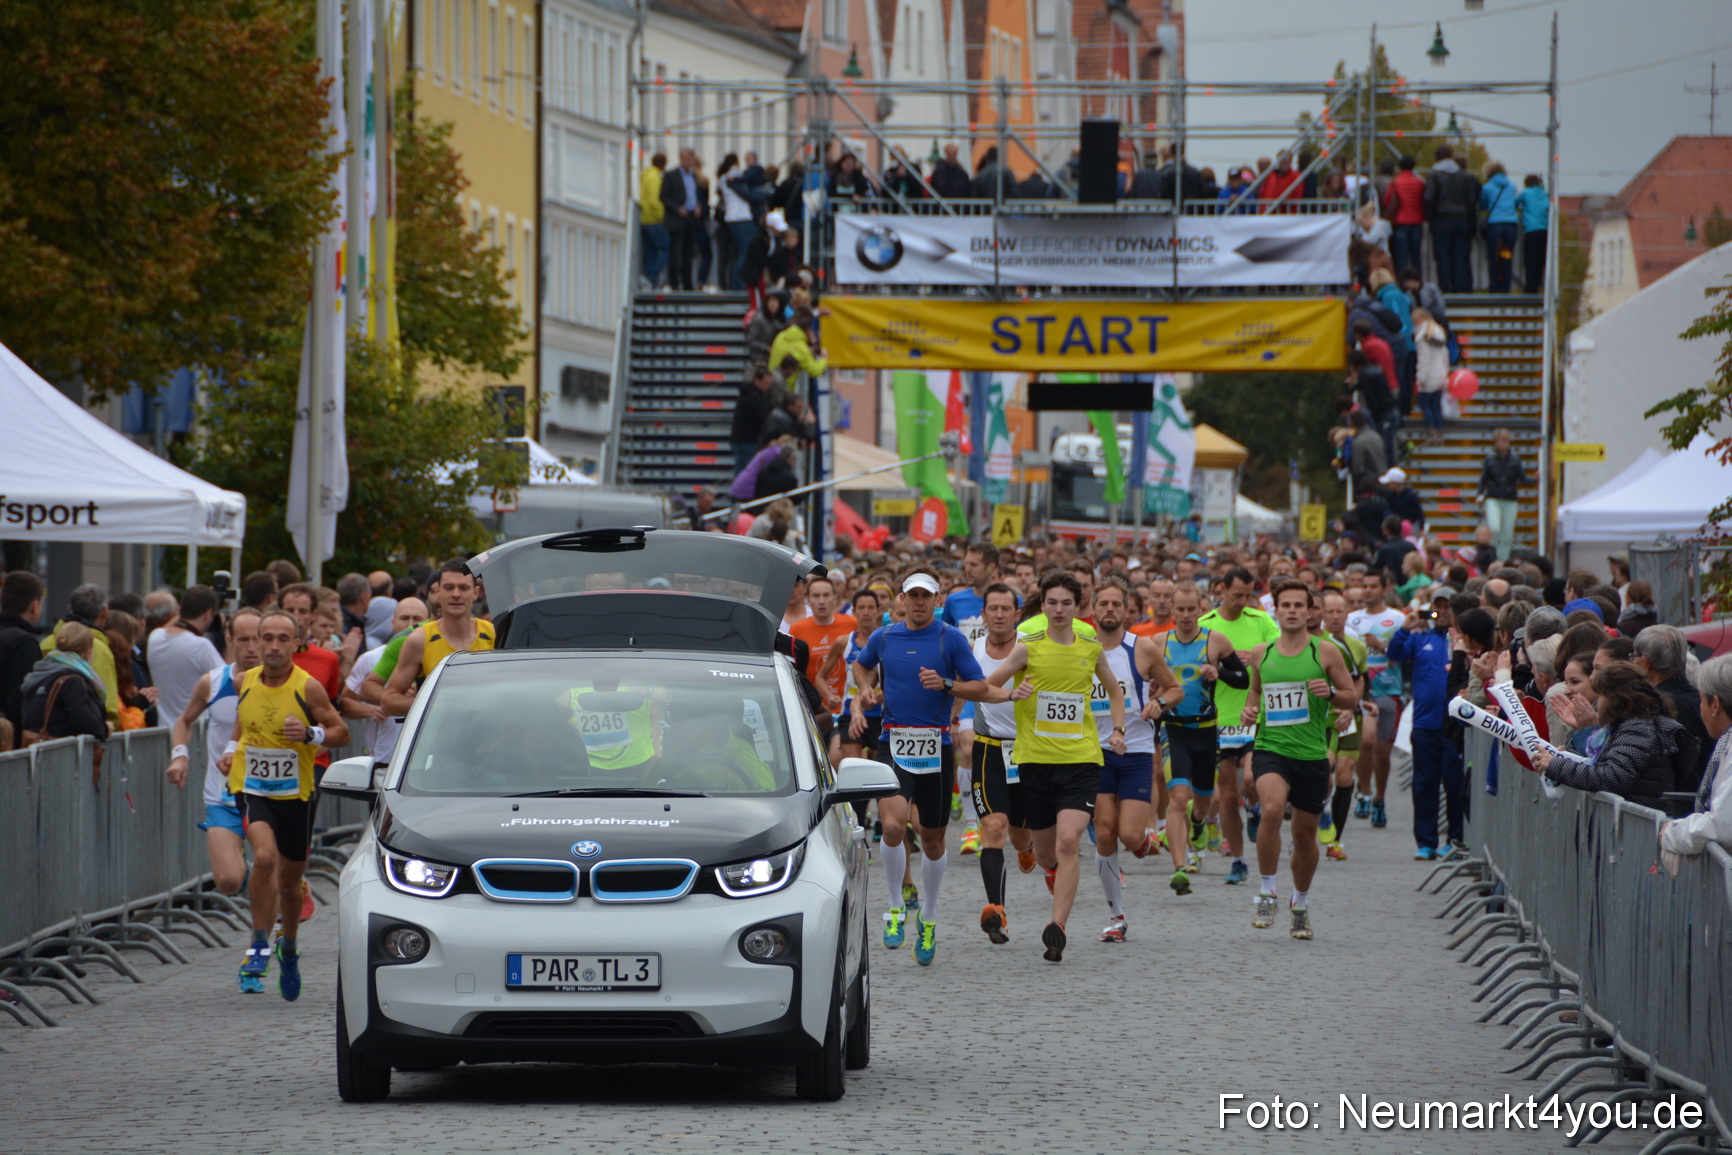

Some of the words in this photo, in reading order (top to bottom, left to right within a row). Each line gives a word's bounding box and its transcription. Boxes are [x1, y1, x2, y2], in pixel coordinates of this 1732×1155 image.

[970, 236, 1018, 251] BMW
[991, 315, 1169, 354] START
[999, 518, 1015, 537] A
[1306, 515, 1319, 533] C
[708, 669, 755, 679] Team
[1267, 691, 1303, 709] 3117
[1047, 702, 1077, 721] 533
[580, 712, 624, 733] 2346
[1480, 715, 1518, 742] BMW
[895, 738, 937, 756] 2273
[249, 758, 294, 778] 2312
[903, 759, 929, 768] Thomas
[511, 972, 518, 980] D
[531, 958, 579, 982] PAR
[597, 958, 629, 982] TL
[635, 958, 649, 982] 3
